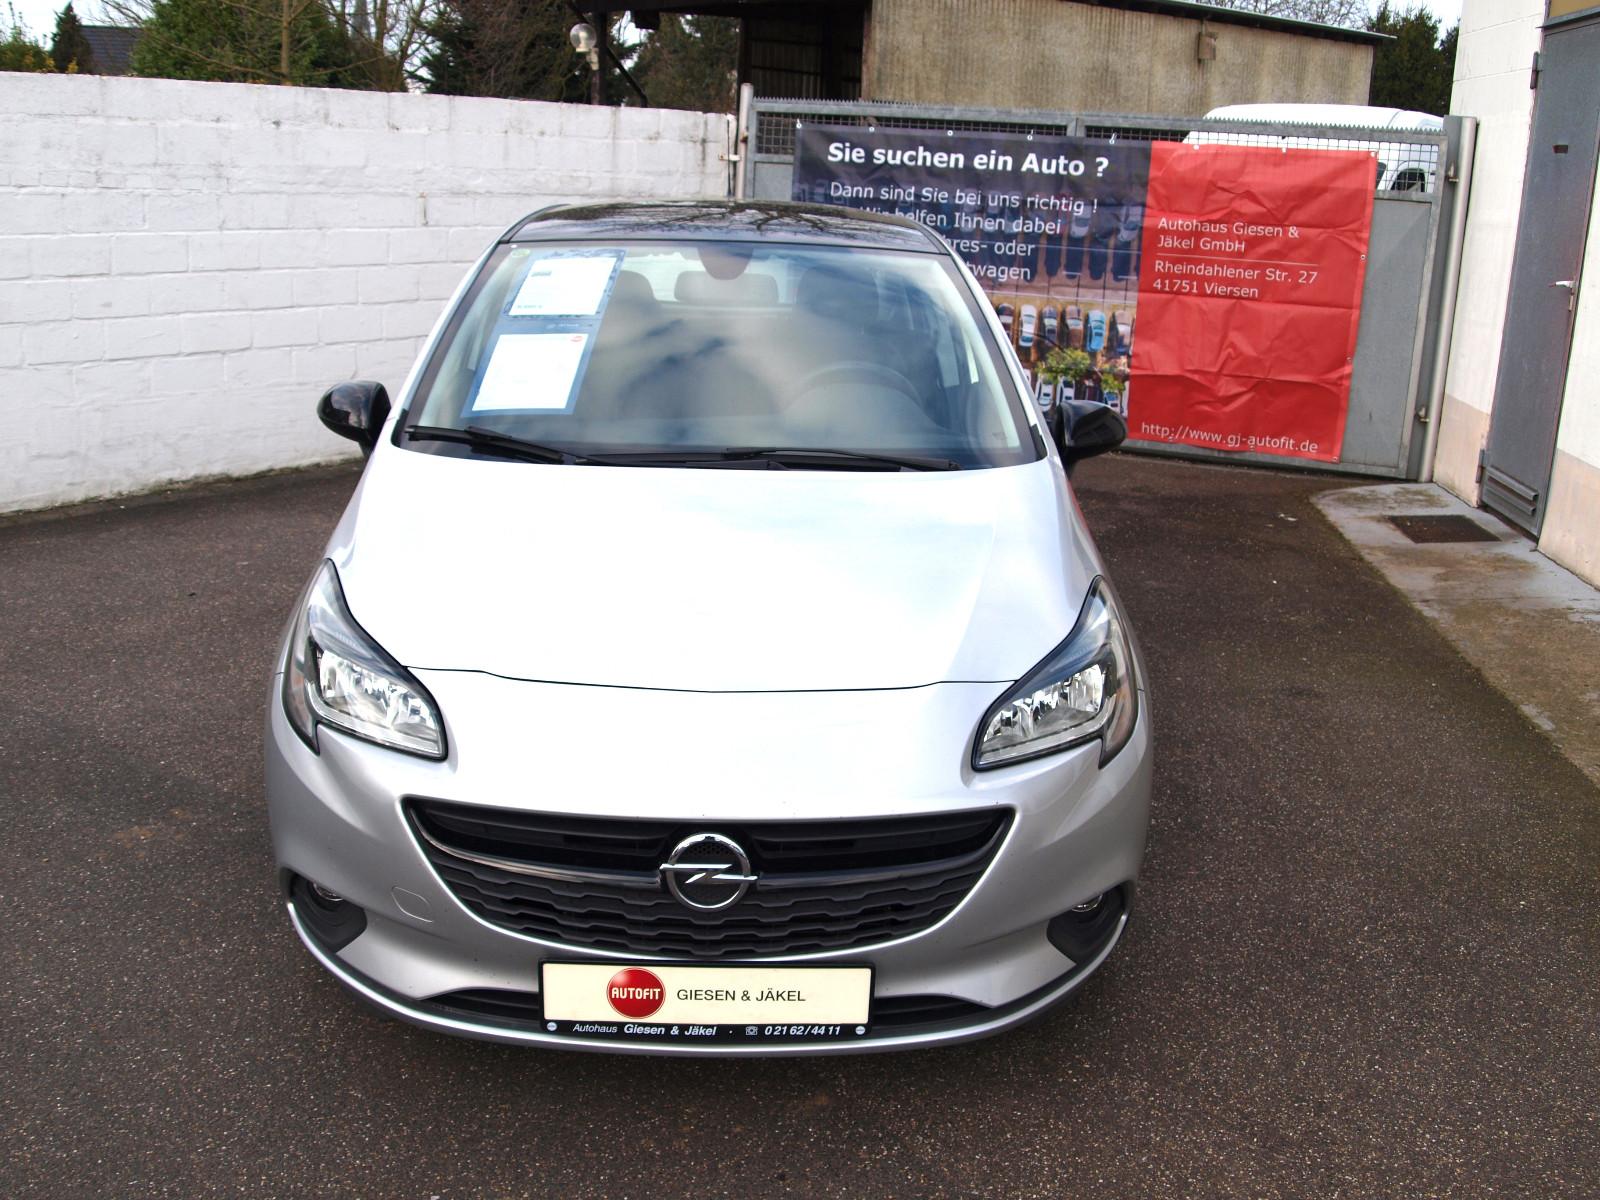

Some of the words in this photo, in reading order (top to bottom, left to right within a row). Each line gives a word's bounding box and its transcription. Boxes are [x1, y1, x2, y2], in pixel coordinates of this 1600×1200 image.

[827, 142, 866, 164] Sie
[872, 146, 964, 169] suchen
[973, 149, 1013, 171] ein
[1021, 153, 1085, 177] Auto
[1095, 157, 1109, 178] ?
[830, 181, 874, 199] Dann
[879, 184, 915, 201] sind
[920, 187, 948, 203] Sie
[955, 188, 981, 206] bei
[988, 193, 1020, 208] uns
[1026, 194, 1085, 215] richtig
[1091, 198, 1098, 213] !
[953, 212, 1005, 231] Ihnen
[1012, 214, 1061, 235] dabei
[1158, 217, 1228, 234] Autohaus
[1233, 221, 1283, 238] Giesen
[1288, 225, 1300, 239] &
[994, 239, 1035, 257] oder
[1157, 234, 1195, 249] Jäkel
[1200, 238, 1245, 253] GmbH
[1154, 260, 1260, 280] Rheindahlener
[1265, 267, 1292, 283] Str.
[1298, 270, 1319, 285] 27
[1153, 278, 1199, 294] 41751
[1204, 282, 1259, 299] Viersen
[1141, 421, 1319, 454] http://www.gj-autofit.de
[611, 986, 661, 1001] AUTOFIT
[676, 989, 736, 1001] GIESEN
[741, 989, 751, 1002] &
[756, 987, 807, 1002] JÄKEL
[572, 1023, 618, 1034] Autohaus
[623, 1023, 666, 1035] Giesen
[670, 1025, 680, 1036] &
[684, 1025, 717, 1036] Jäkel
